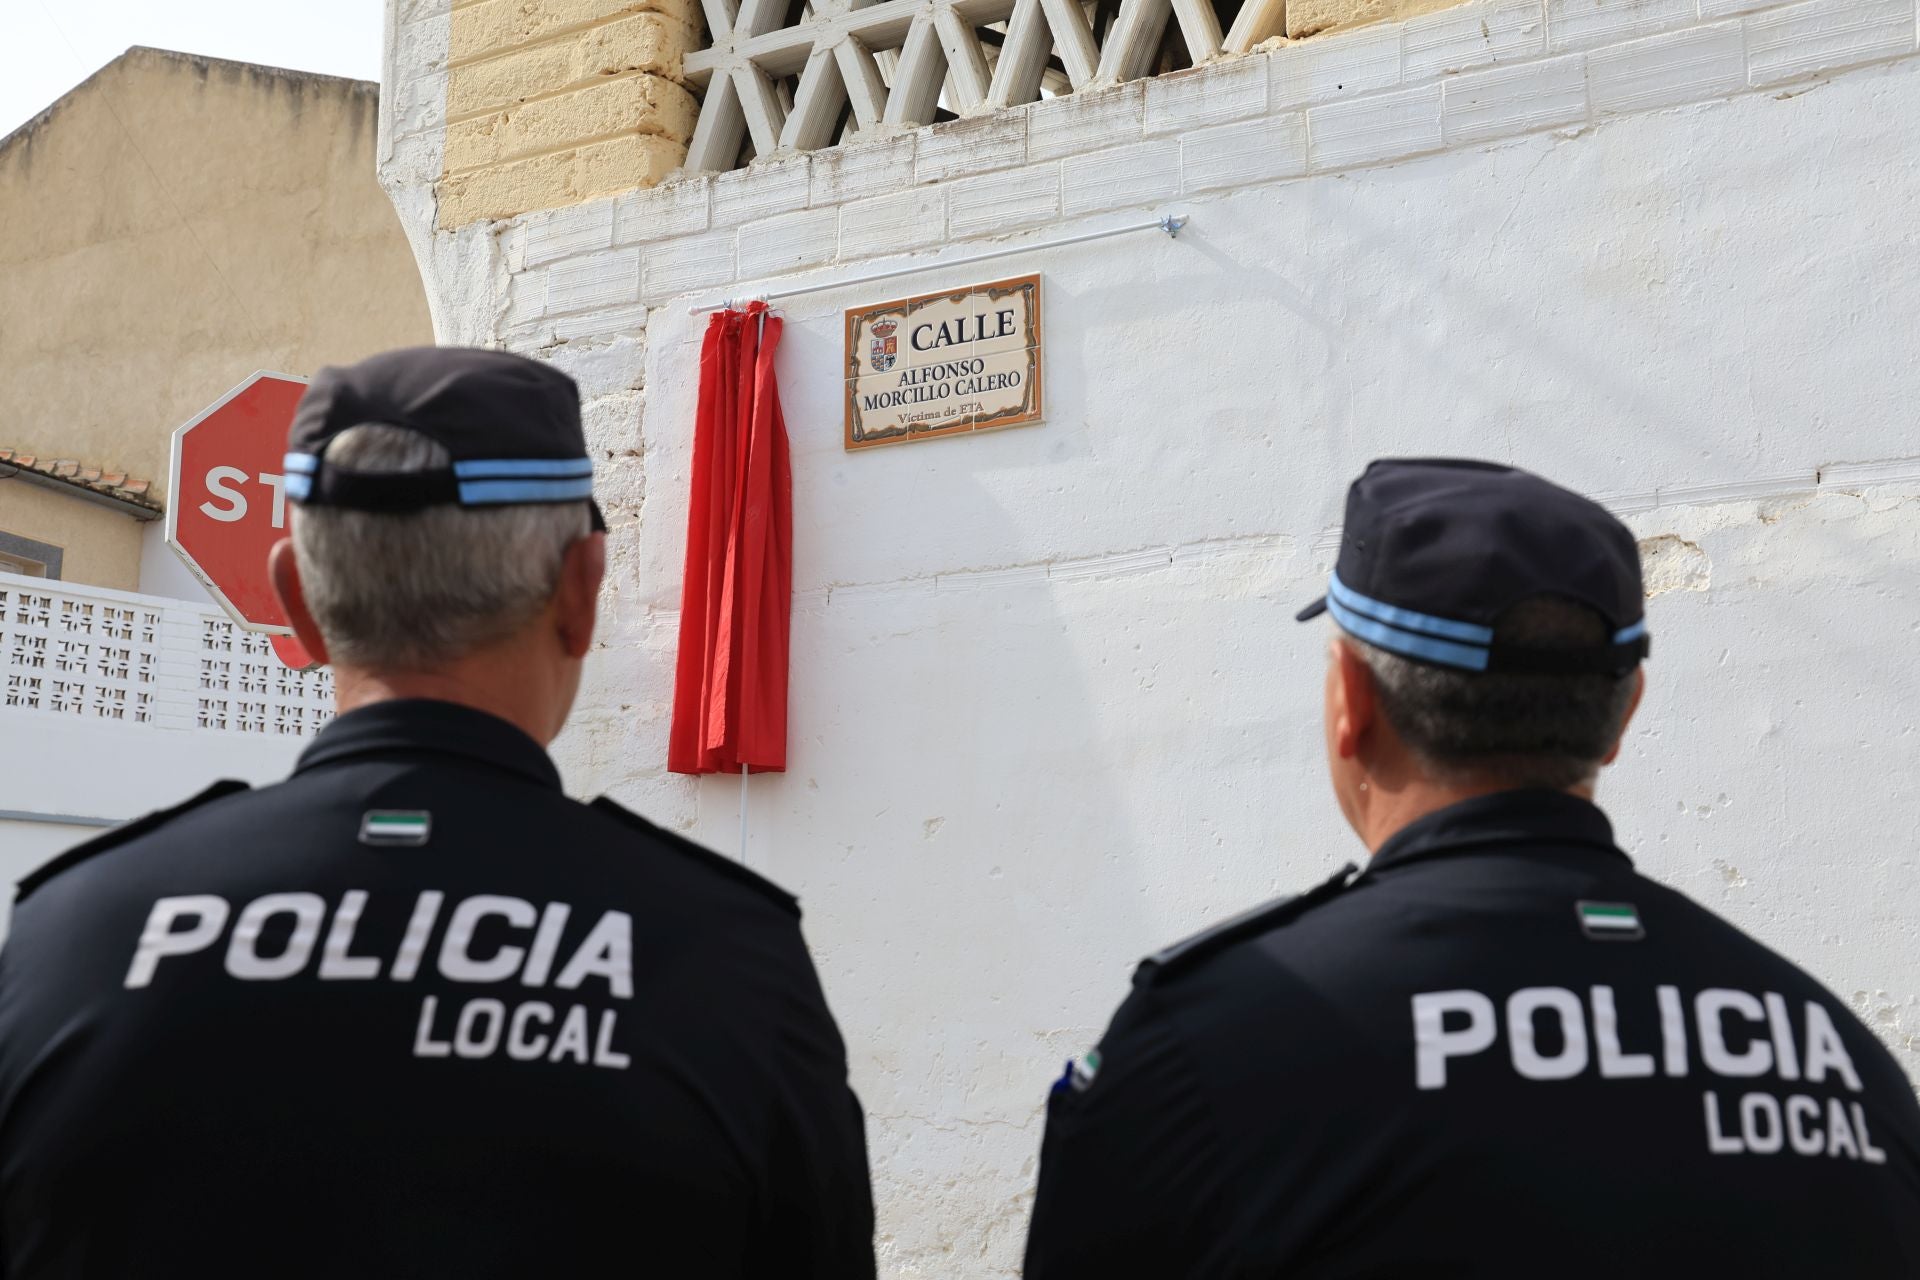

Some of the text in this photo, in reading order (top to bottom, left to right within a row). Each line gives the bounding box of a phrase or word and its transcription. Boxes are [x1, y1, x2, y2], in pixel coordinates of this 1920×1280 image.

[911, 309, 1016, 351] CALLE
[864, 371, 1021, 411] MORCILLO CALERO
[898, 358, 985, 387] ALFONSO
[897, 401, 985, 424] Víctima de ETA
[199, 465, 285, 528] ST
[124, 890, 633, 999] POLICIA
[413, 996, 631, 1069] LOCAL
[1411, 984, 1863, 1091] POLICIA
[1703, 1091, 1887, 1163] LOCAL
